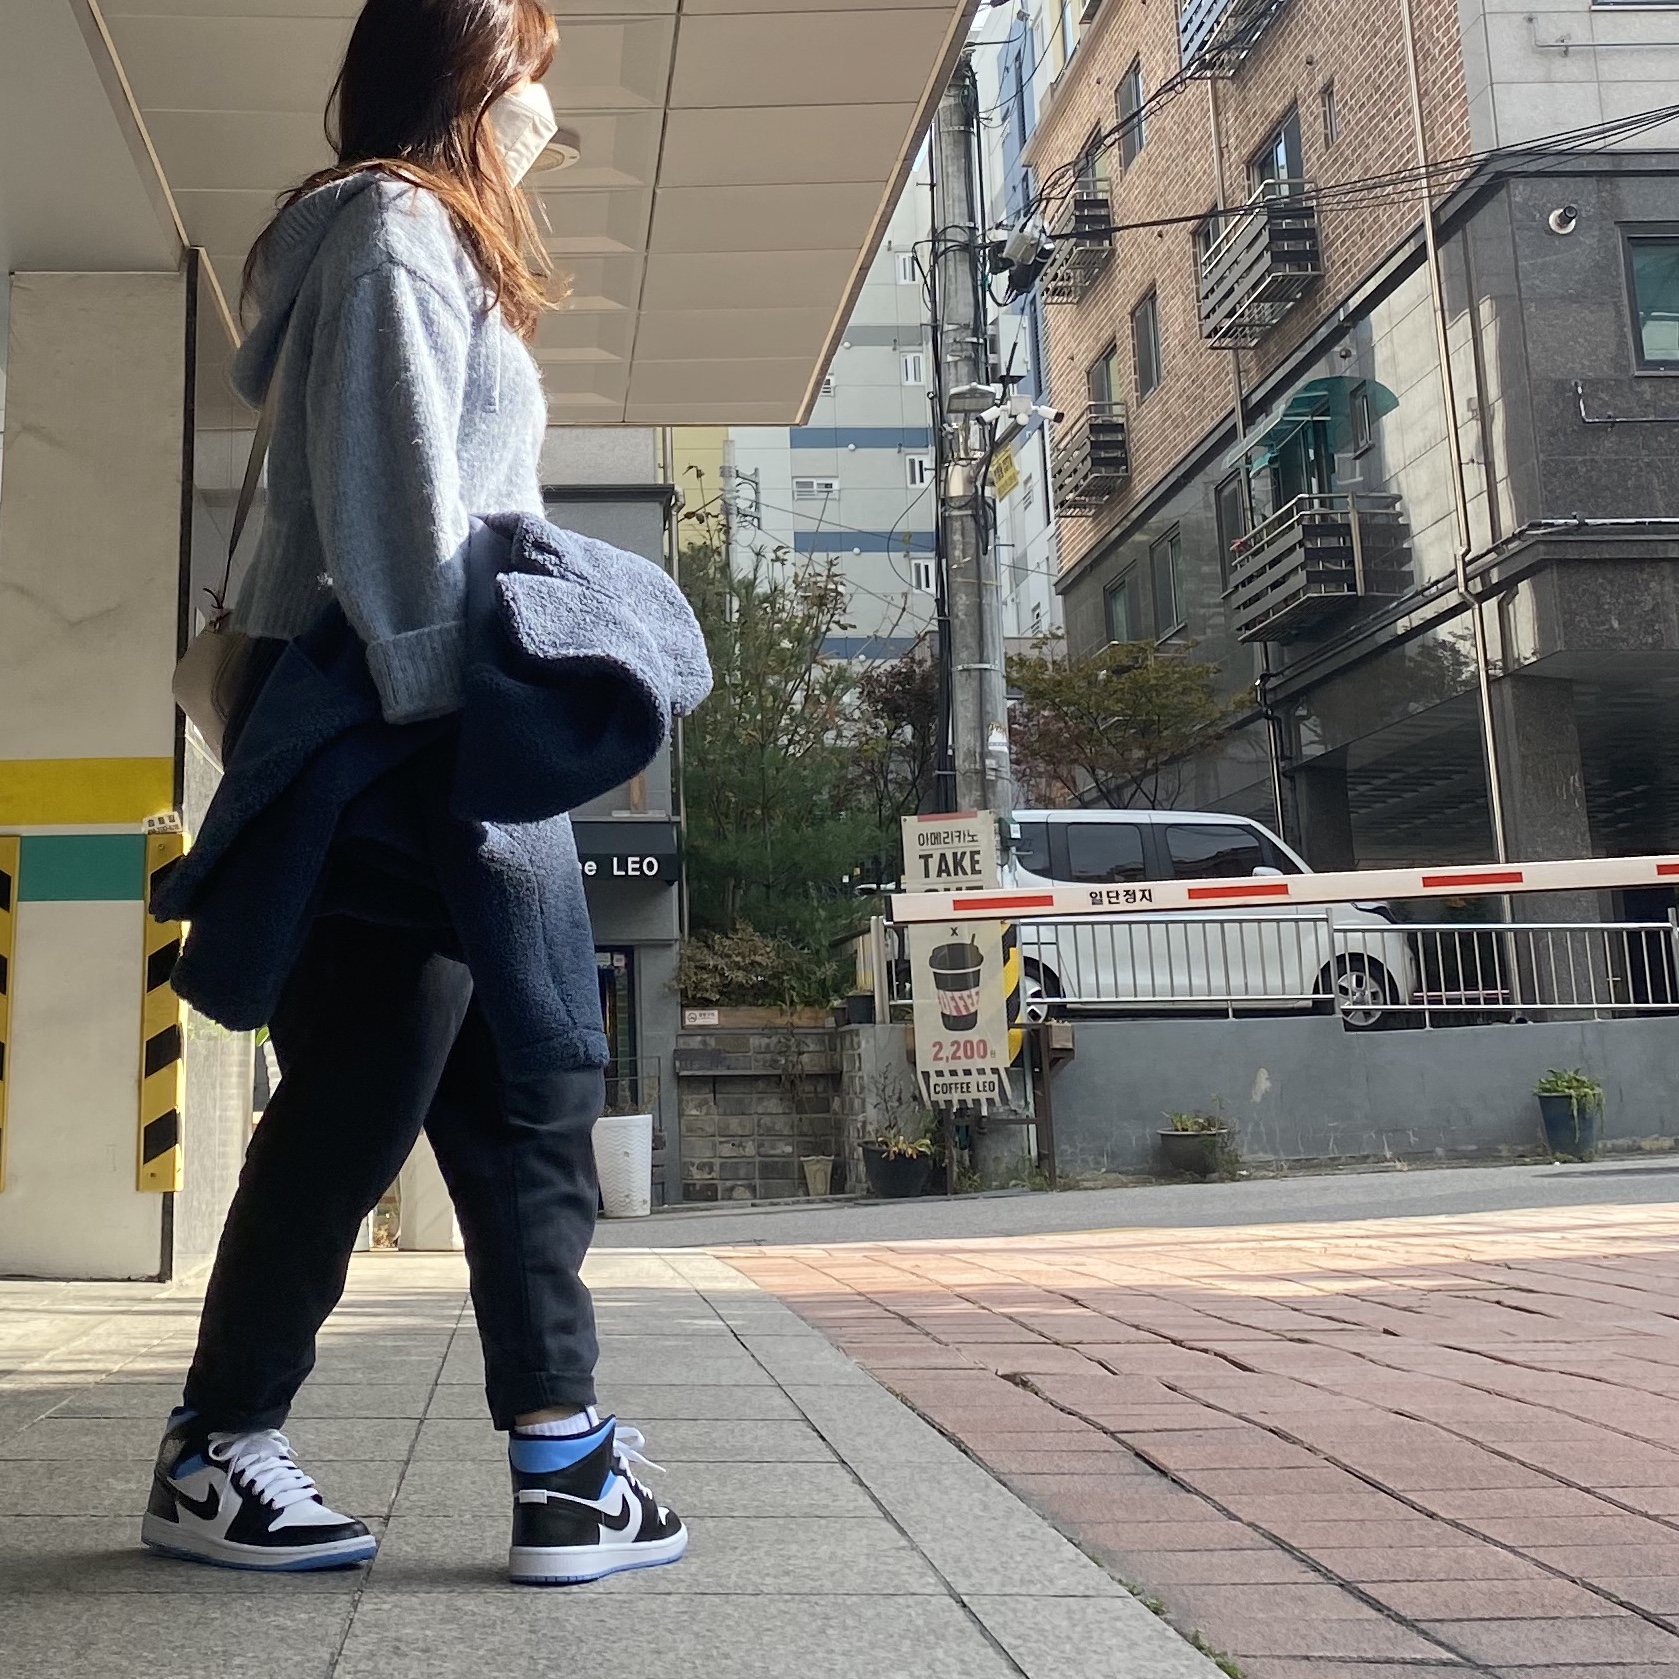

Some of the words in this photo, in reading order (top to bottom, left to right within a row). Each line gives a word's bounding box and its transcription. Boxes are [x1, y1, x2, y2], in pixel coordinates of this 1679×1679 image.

[917, 829, 979, 847] 아메리카노
[612, 856, 659, 876] LEO
[918, 850, 982, 879] TAKE
[1089, 888, 1153, 906] 일단정지
[933, 1081, 972, 1095] COFFEE
[976, 1080, 996, 1093] LEO
